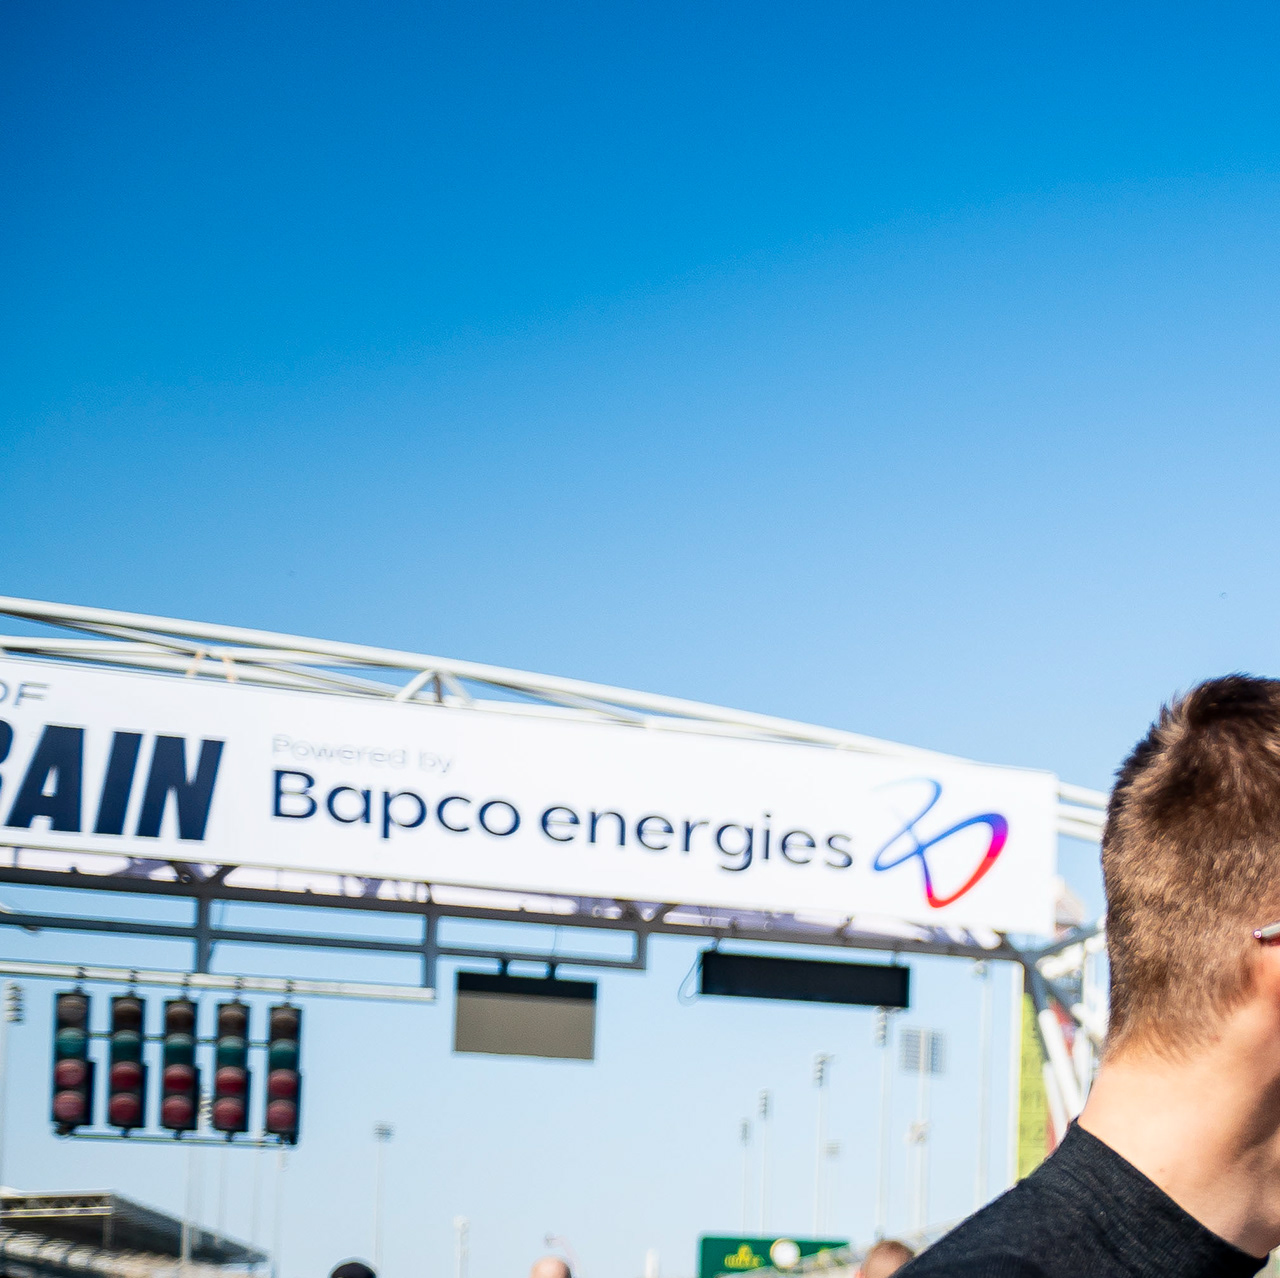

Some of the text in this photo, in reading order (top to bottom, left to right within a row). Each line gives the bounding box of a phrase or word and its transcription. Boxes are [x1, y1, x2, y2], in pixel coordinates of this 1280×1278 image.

[272, 735, 454, 773] Powered by
[273, 768, 854, 872] Bapco energies
